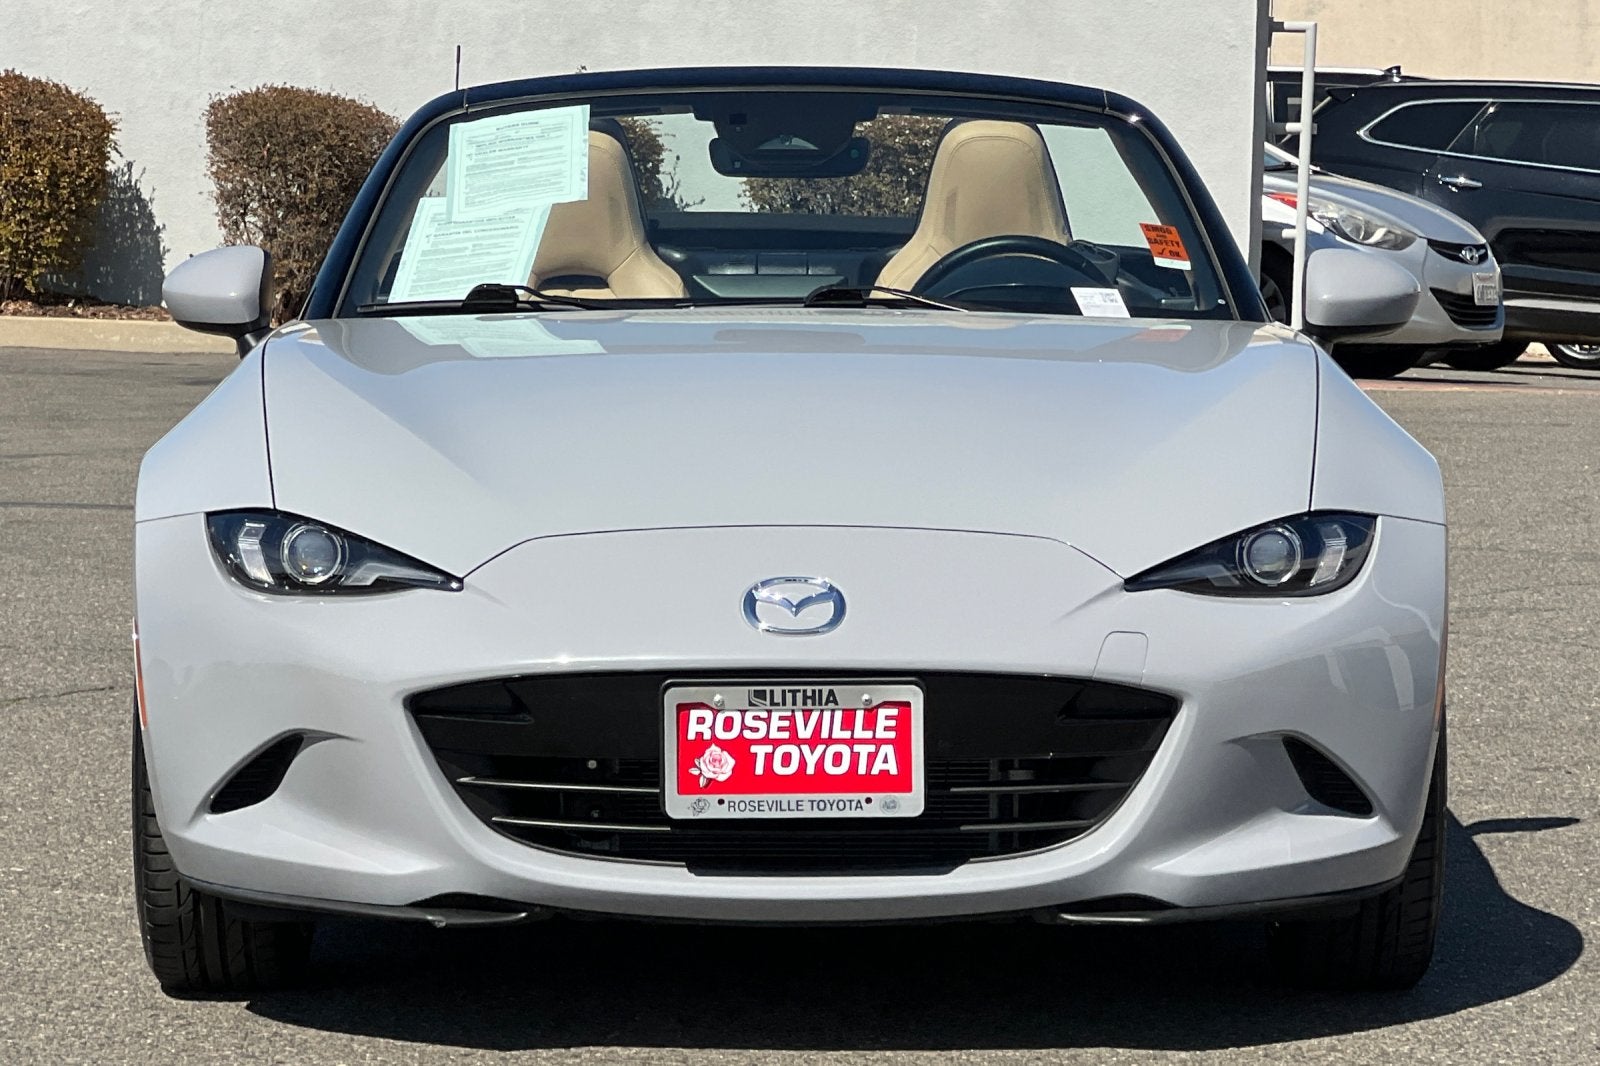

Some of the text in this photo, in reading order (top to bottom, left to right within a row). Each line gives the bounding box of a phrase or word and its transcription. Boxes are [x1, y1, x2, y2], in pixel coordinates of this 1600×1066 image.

[1147, 237, 1181, 248] SAFETY
[769, 689, 839, 707] LITHIA
[687, 708, 899, 740] ROSEVILLE
[750, 744, 899, 775] TOYOTA
[727, 799, 864, 812] ROSEVILLE TOYOTA
